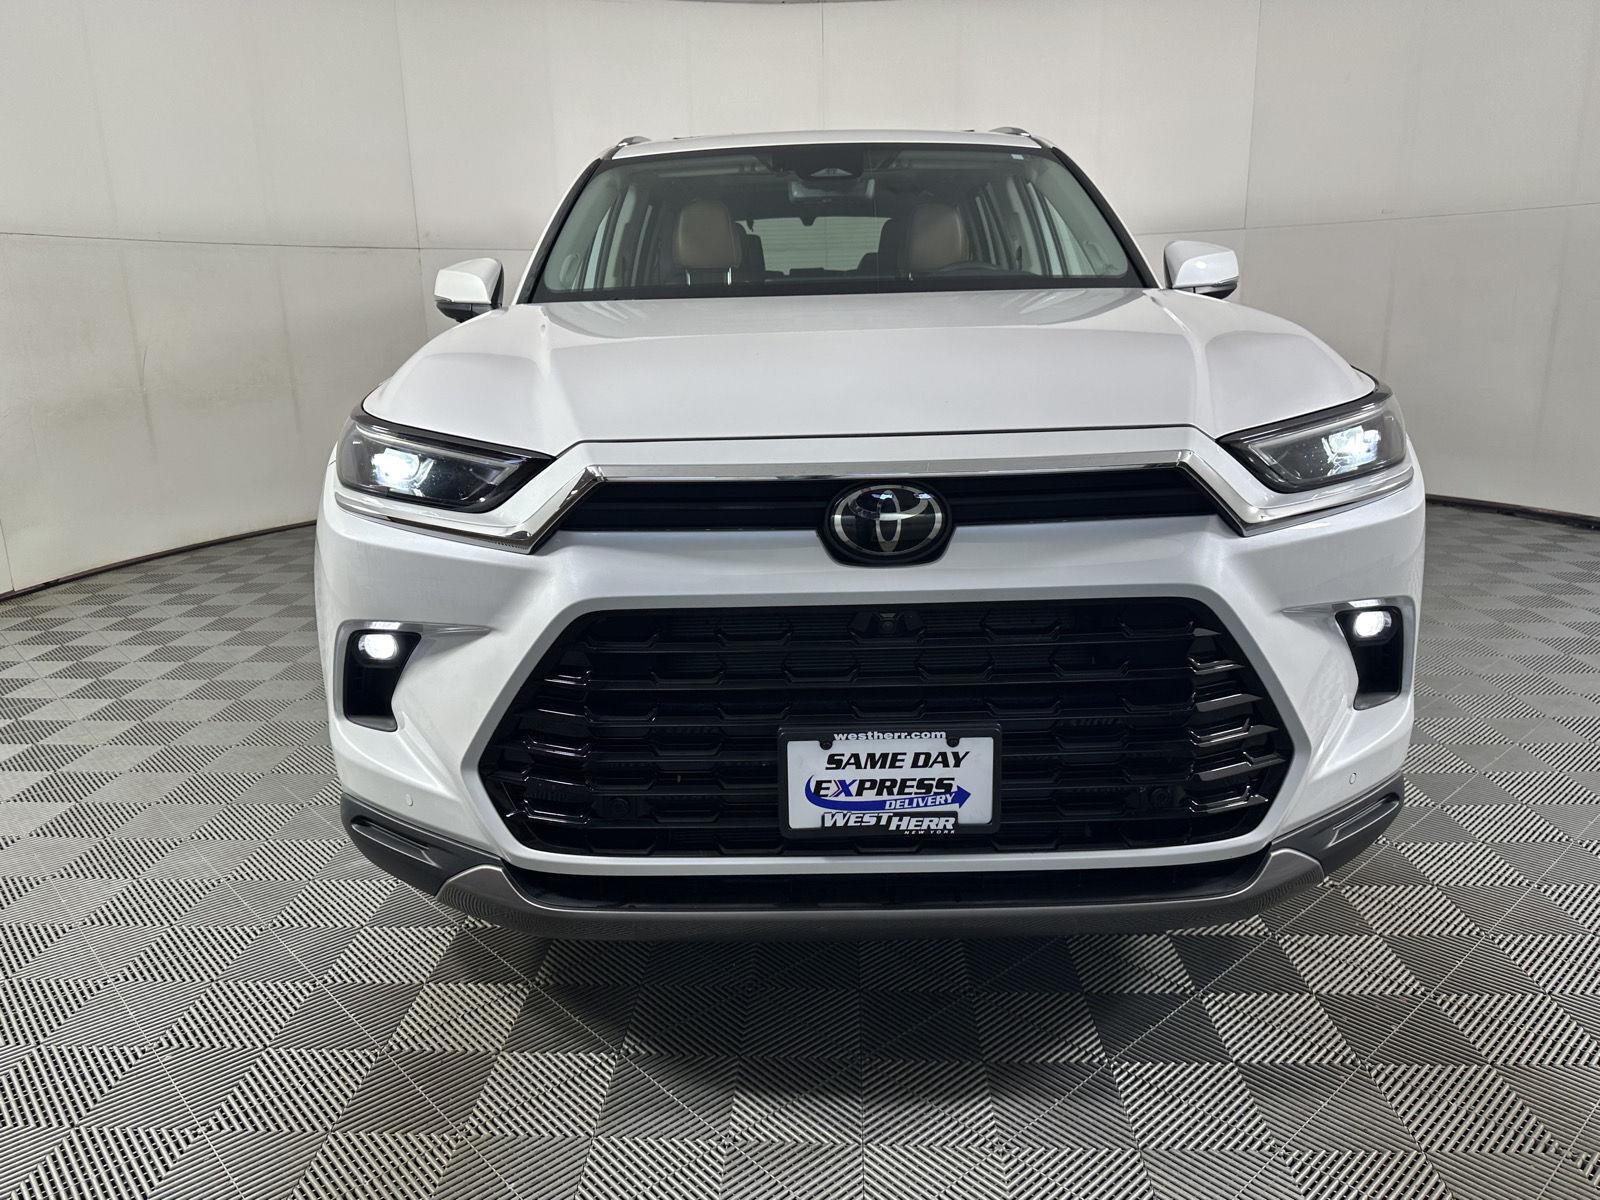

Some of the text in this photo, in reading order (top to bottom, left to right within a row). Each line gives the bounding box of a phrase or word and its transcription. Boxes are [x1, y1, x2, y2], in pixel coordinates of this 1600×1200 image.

[833, 731, 946, 741] westherr.com
[825, 751, 971, 770] SAME DAY
[812, 777, 955, 798] EXPRESS
[884, 793, 956, 811] DELIVERY
